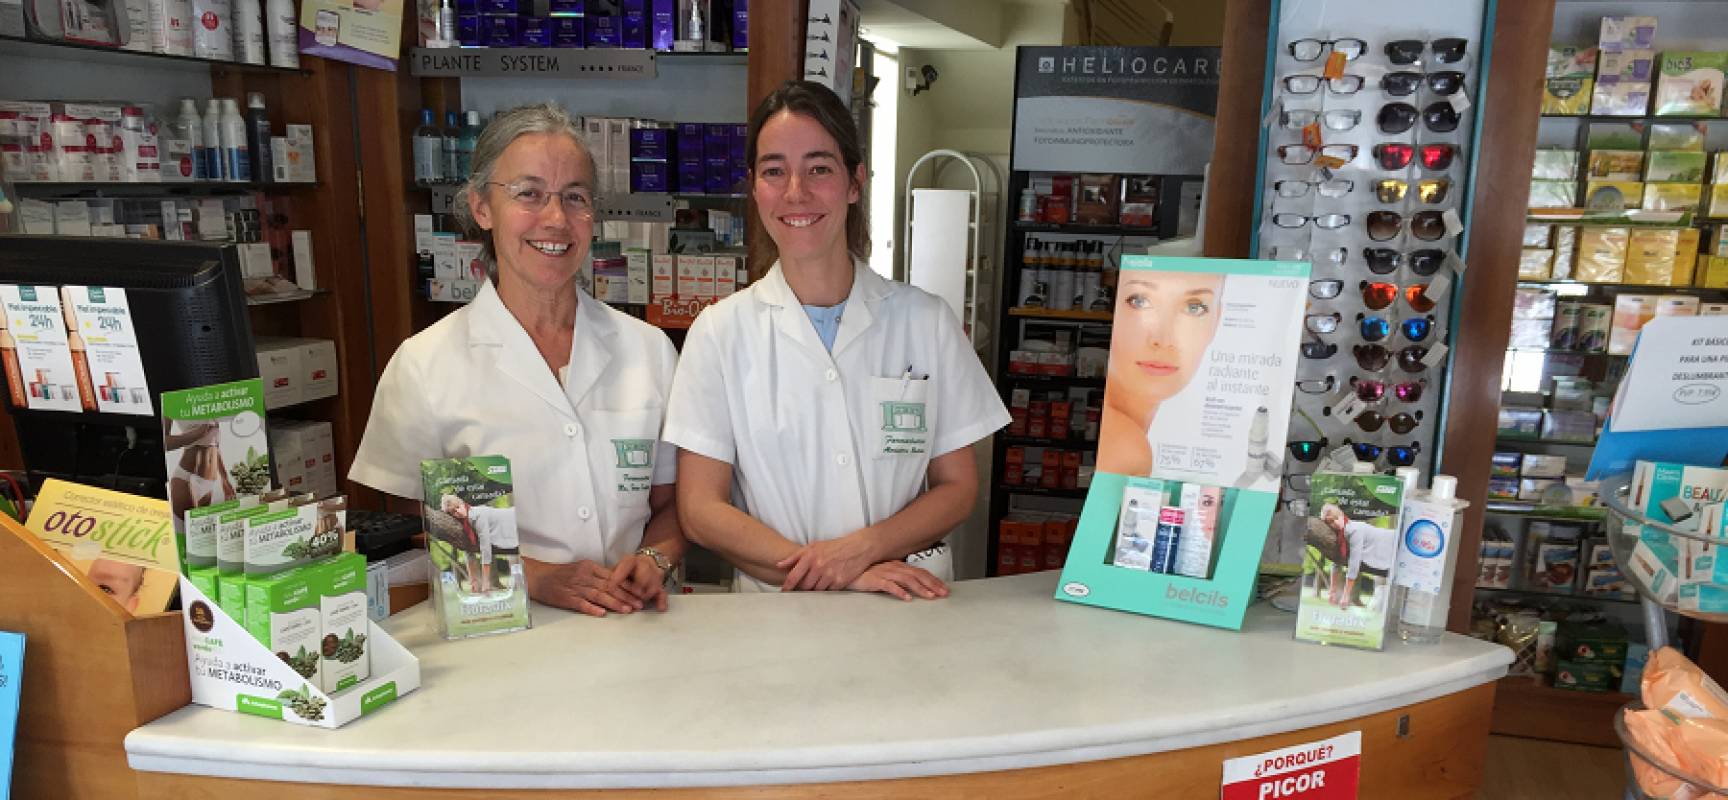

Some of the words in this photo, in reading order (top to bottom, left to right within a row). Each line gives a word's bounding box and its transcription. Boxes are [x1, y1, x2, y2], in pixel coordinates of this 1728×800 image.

[422, 55, 481, 71] PLANTE
[500, 55, 560, 72] SYSTEM
[617, 65, 644, 73] FRANCE
[1063, 57, 1221, 75] HELIOCAR
[1667, 57, 1693, 71] bio3
[635, 208, 661, 217] FRANCE
[451, 281, 477, 299] bel
[662, 298, 700, 317] Bio-O
[28, 314, 54, 329] 24h
[98, 315, 122, 330] 24h
[1211, 350, 1236, 363] Una
[1238, 353, 1282, 367] mirada
[1208, 364, 1260, 381] radiante
[186, 391, 214, 405] Ayuda
[220, 386, 249, 398] activar
[1206, 377, 1218, 392] al
[1220, 380, 1270, 396] instante
[180, 408, 190, 418] tu
[191, 396, 255, 417] METABOLISMO
[1684, 484, 1724, 502] BEAU
[258, 523, 312, 543] METABOLISMO
[1164, 583, 1230, 608] belcils
[195, 653, 223, 668] Ayuda
[233, 661, 266, 676] activar
[196, 664, 206, 676] tu
[208, 667, 283, 691] METABOLISMO
[1254, 744, 1334, 778] ¿PORQUÉ?
[1258, 770, 1326, 800] PICOR
